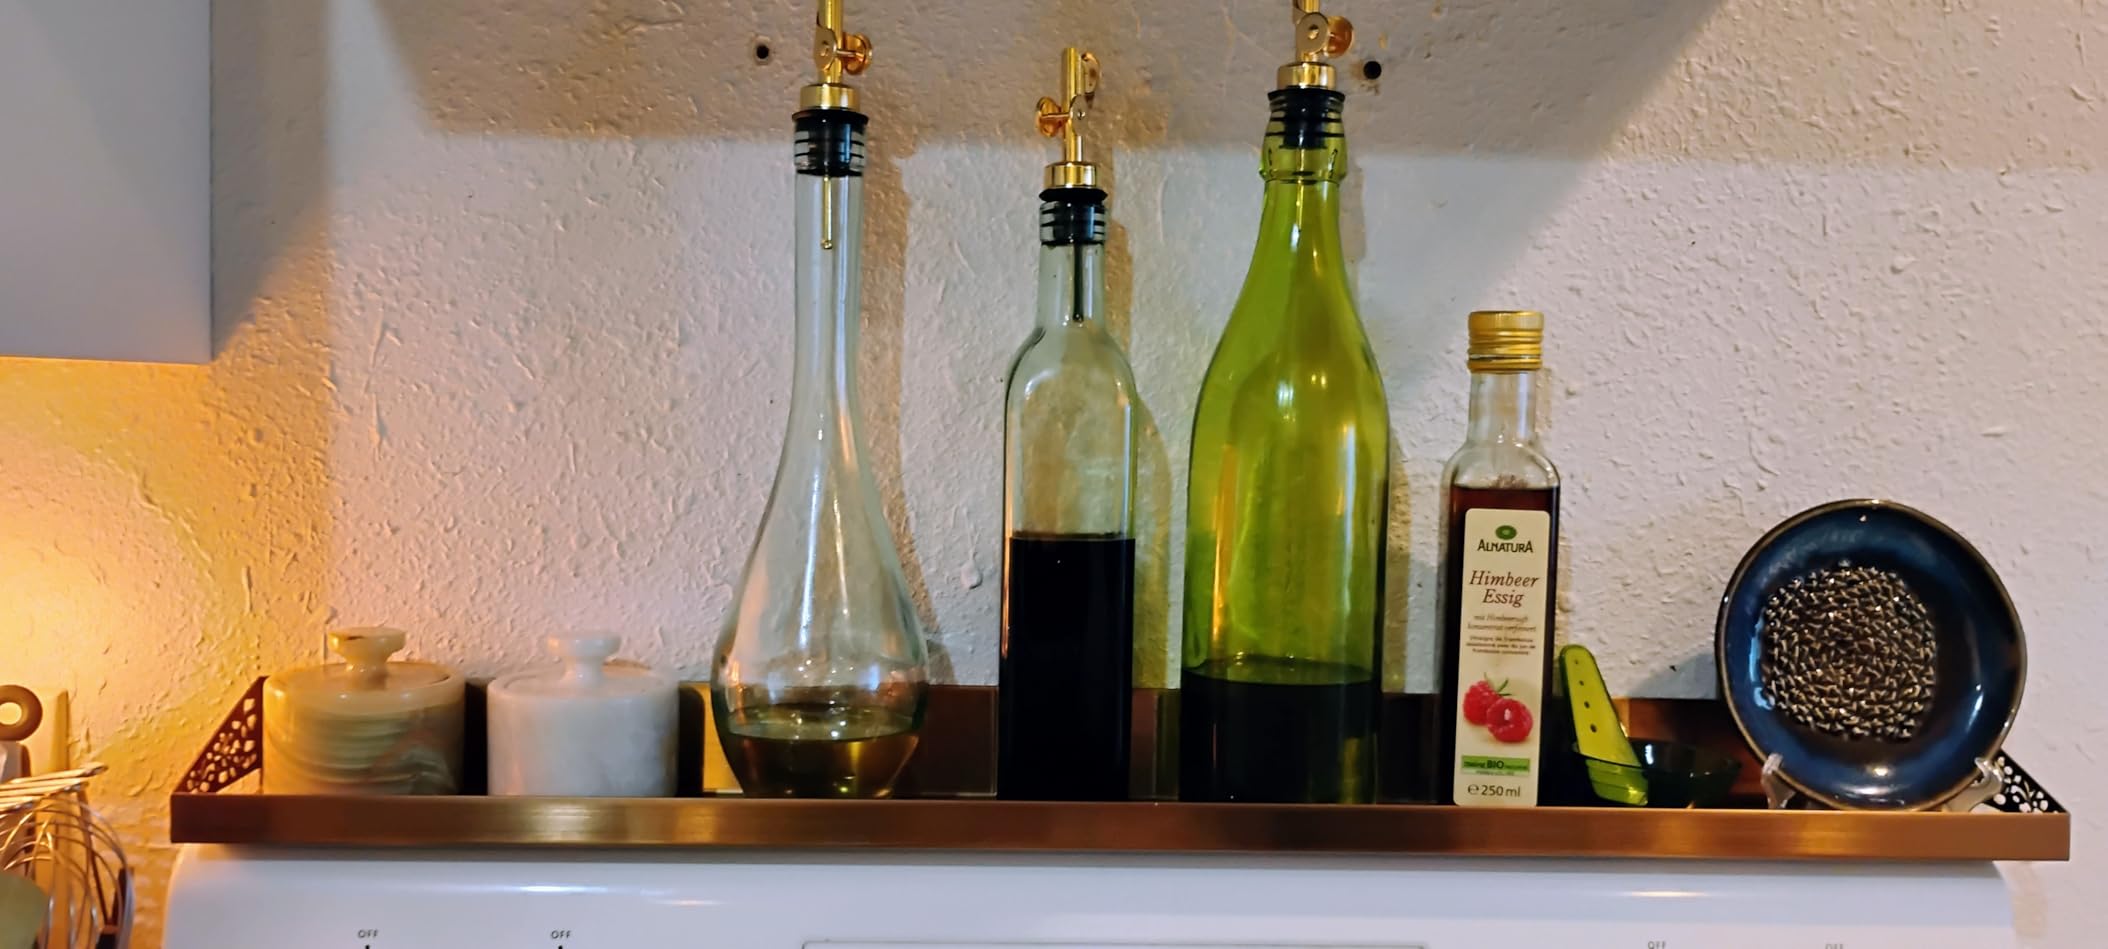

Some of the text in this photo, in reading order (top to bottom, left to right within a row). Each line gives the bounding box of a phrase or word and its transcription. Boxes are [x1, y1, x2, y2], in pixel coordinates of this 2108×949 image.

[1477, 539, 1533, 553] ALNATURA
[1469, 570, 1540, 588] Himbeer
[1482, 588, 1524, 608] Essig
[1487, 760, 1504, 769] BIO
[1481, 785, 1504, 797] 250
[1506, 786, 1520, 797] ml
[357, 929, 379, 939] OFF
[551, 930, 571, 939] OFF
